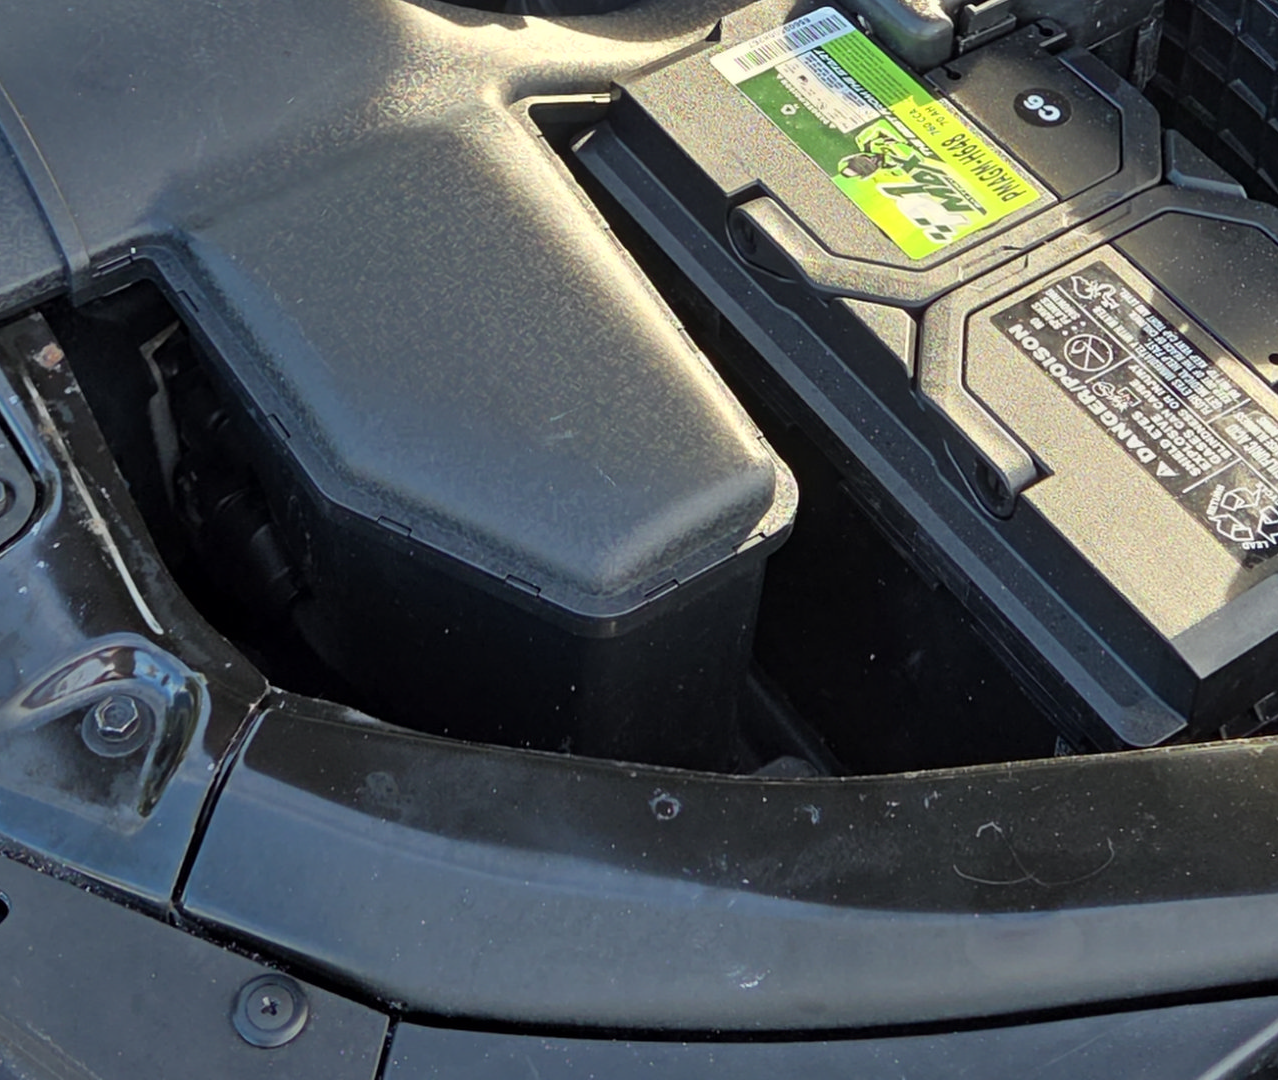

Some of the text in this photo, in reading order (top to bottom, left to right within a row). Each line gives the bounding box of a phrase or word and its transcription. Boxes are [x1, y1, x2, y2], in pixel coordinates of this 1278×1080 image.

[811, 46, 848, 77] START
[841, 74, 866, 93] THE
[858, 89, 892, 116] FROM
[906, 107, 927, 123] CCA
[923, 105, 950, 126] 70 AH
[1023, 94, 1061, 122] C6
[938, 131, 1028, 203] PMAGM-H648
[888, 153, 974, 213] MAX
[1028, 300, 1065, 330] SPARKS
[1152, 333, 1168, 345] OF
[1160, 328, 1180, 343] CAP
[1160, 341, 1187, 361] REACH
[1179, 357, 1197, 371] THE
[1186, 352, 1209, 370] KEEP
[1140, 337, 1224, 410] GET MEDICAL HELP FAST.
[1190, 367, 1206, 379] OF
[1006, 322, 1158, 465] DANGER/POISON
[1169, 377, 1194, 397] EYES
[1126, 361, 1234, 460] BLINDNESS OR INJURY
[1127, 377, 1224, 466] GASES CAN CAUSE
[1128, 409, 1203, 478] SHIELD EYES
[1148, 411, 1213, 471] EXPLOSIVE
[1221, 421, 1253, 446] ACID
[1241, 540, 1268, 549] LEAD
